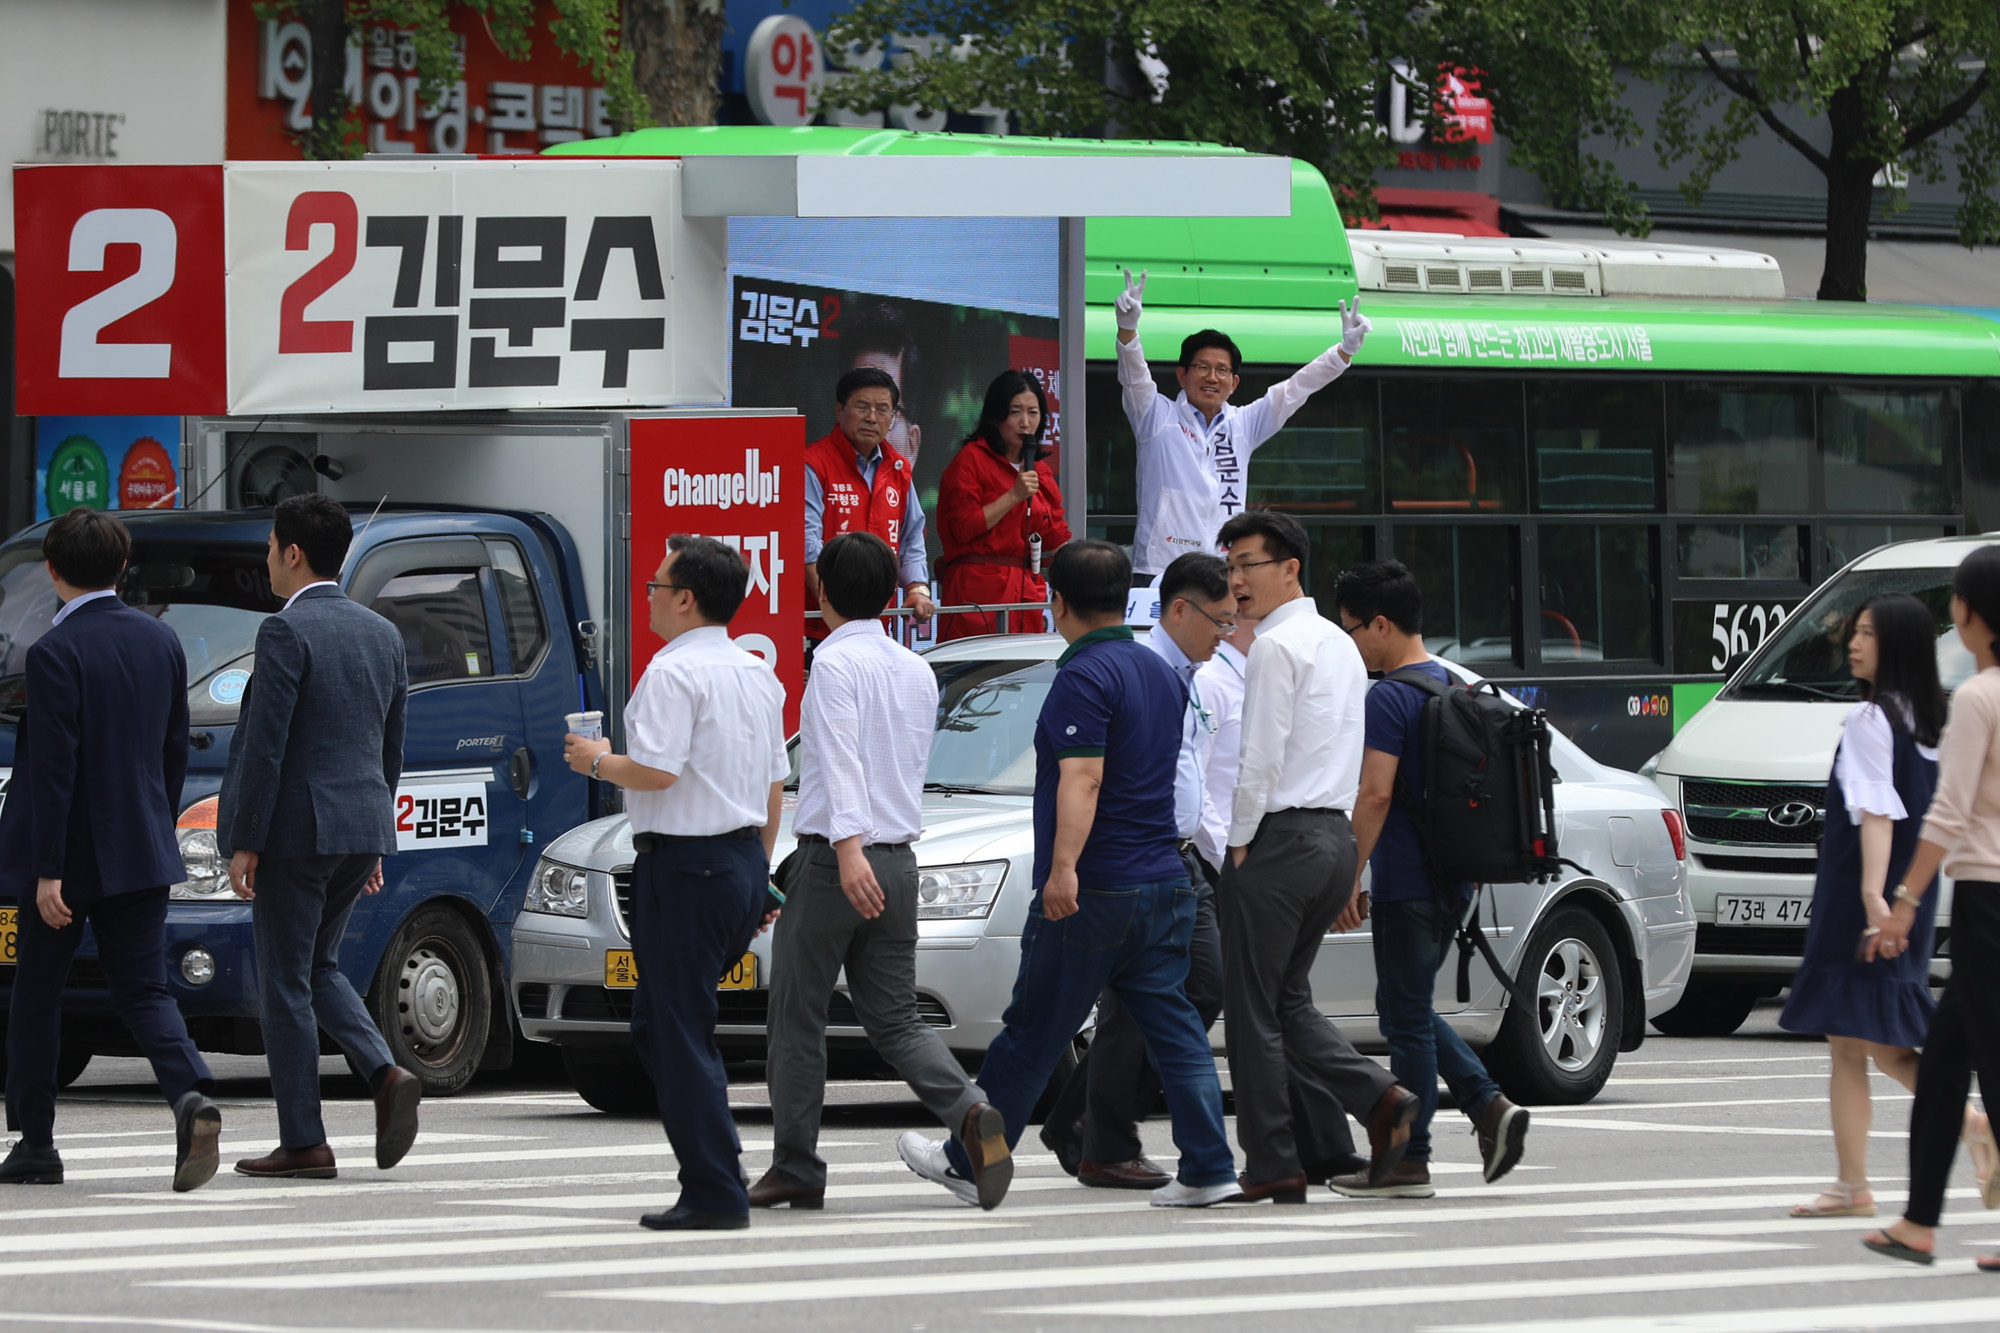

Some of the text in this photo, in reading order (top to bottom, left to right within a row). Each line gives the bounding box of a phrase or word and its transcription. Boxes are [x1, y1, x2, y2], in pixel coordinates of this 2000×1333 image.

[771, 33, 814, 117] 약
[58, 208, 177, 378] 2
[1396, 321, 1441, 357] 시민과
[1438, 322, 1471, 358] 함께
[1468, 323, 1514, 360] 만드는
[1513, 325, 1557, 362] 최고의
[1623, 326, 1653, 362] 서울
[1214, 432, 1241, 515] 김문수
[827, 493, 860, 506] 구청장
[1728, 900, 1765, 920] 73라
[616, 956, 629, 982] 서울
